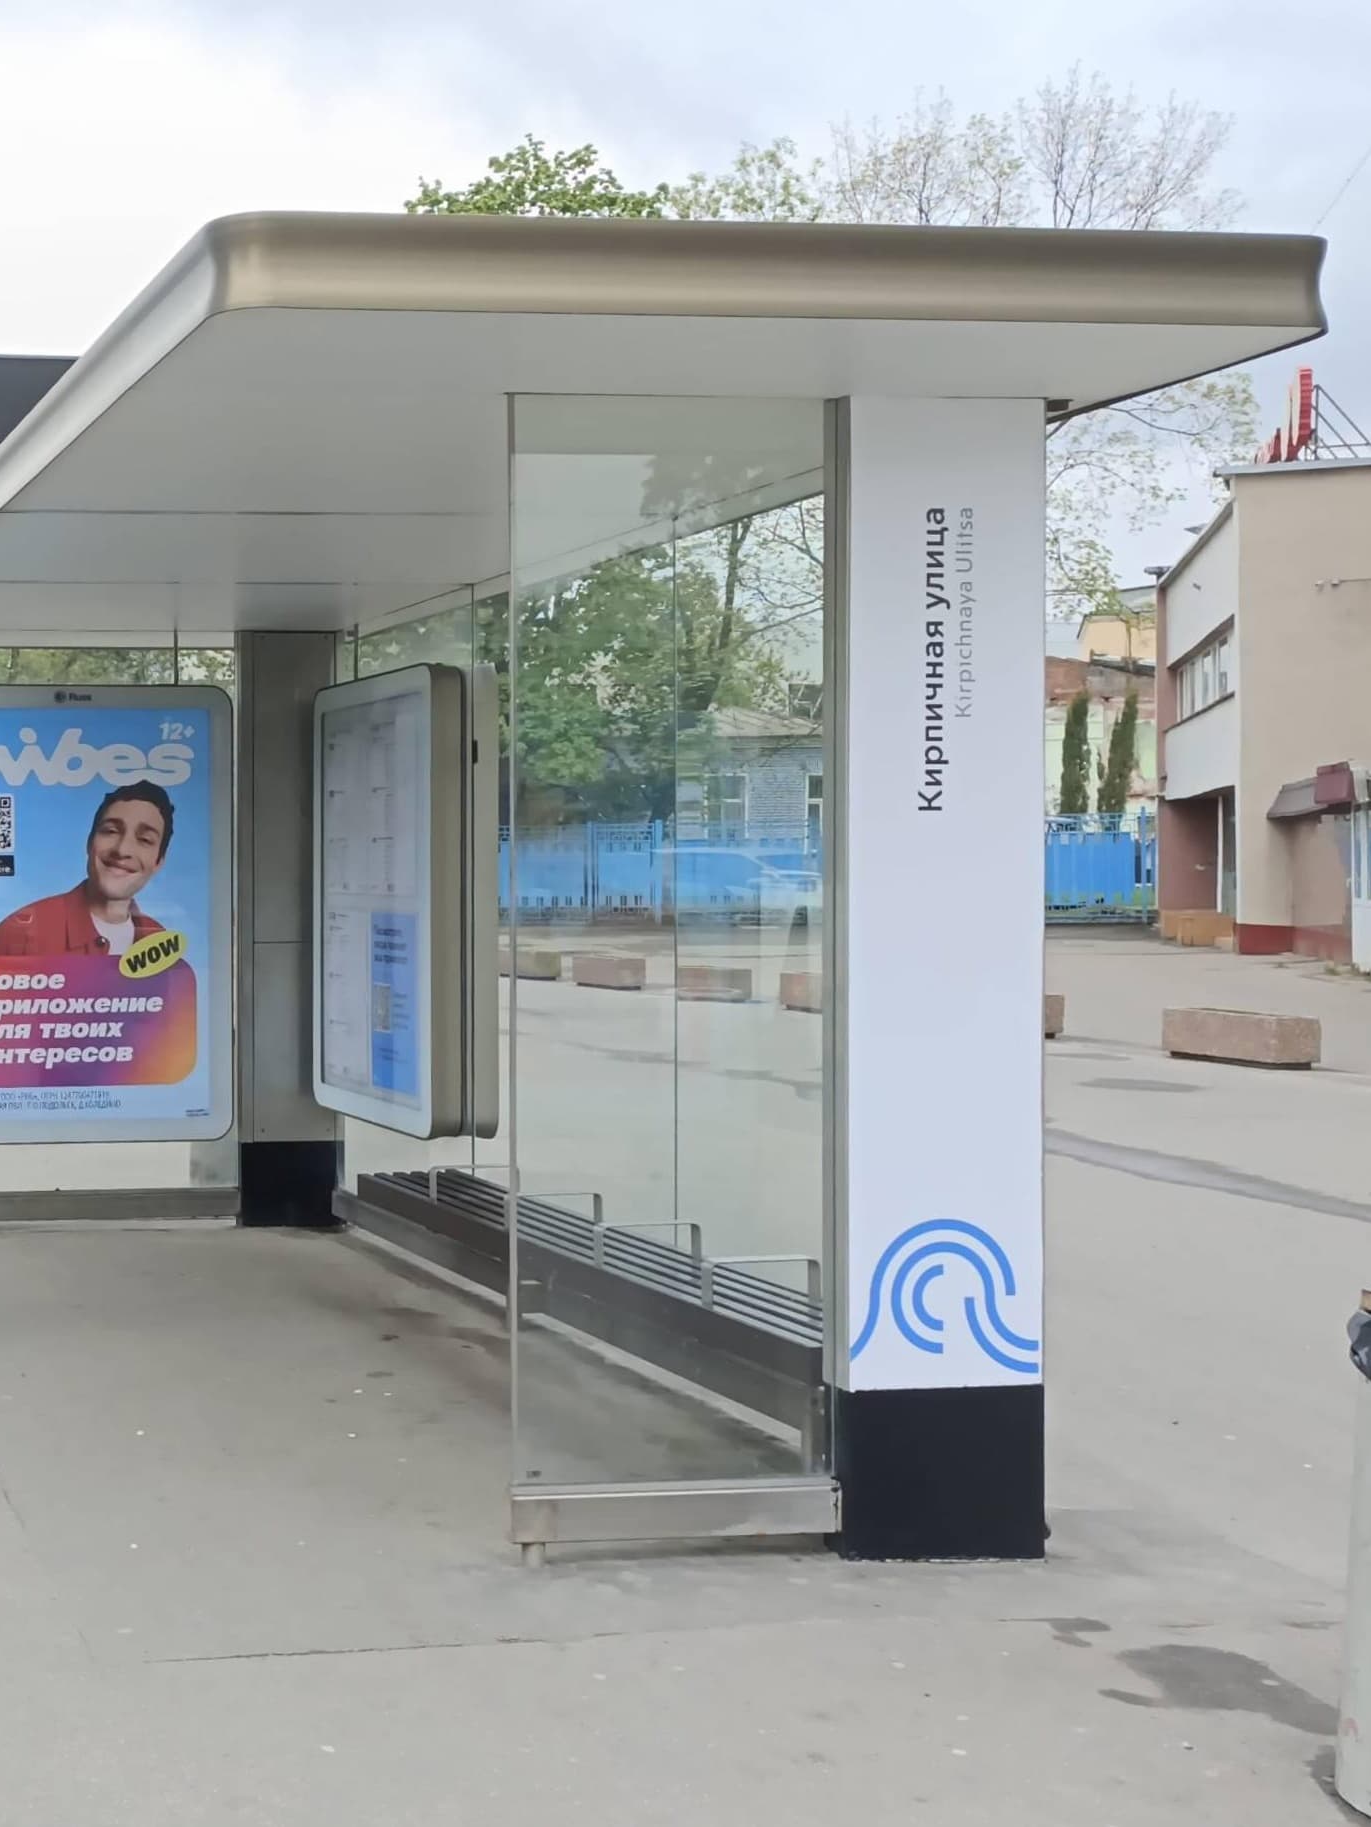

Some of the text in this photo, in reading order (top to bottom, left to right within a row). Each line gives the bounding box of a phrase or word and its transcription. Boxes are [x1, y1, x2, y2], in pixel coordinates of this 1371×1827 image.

[954, 507, 977, 718] Kirpichnaya Ulitsa
[917, 507, 951, 811] Кирпичная улица
[158, 722, 196, 741] 12+
[126, 934, 180, 974] WOW
[39, 1021, 124, 1039] твоих
